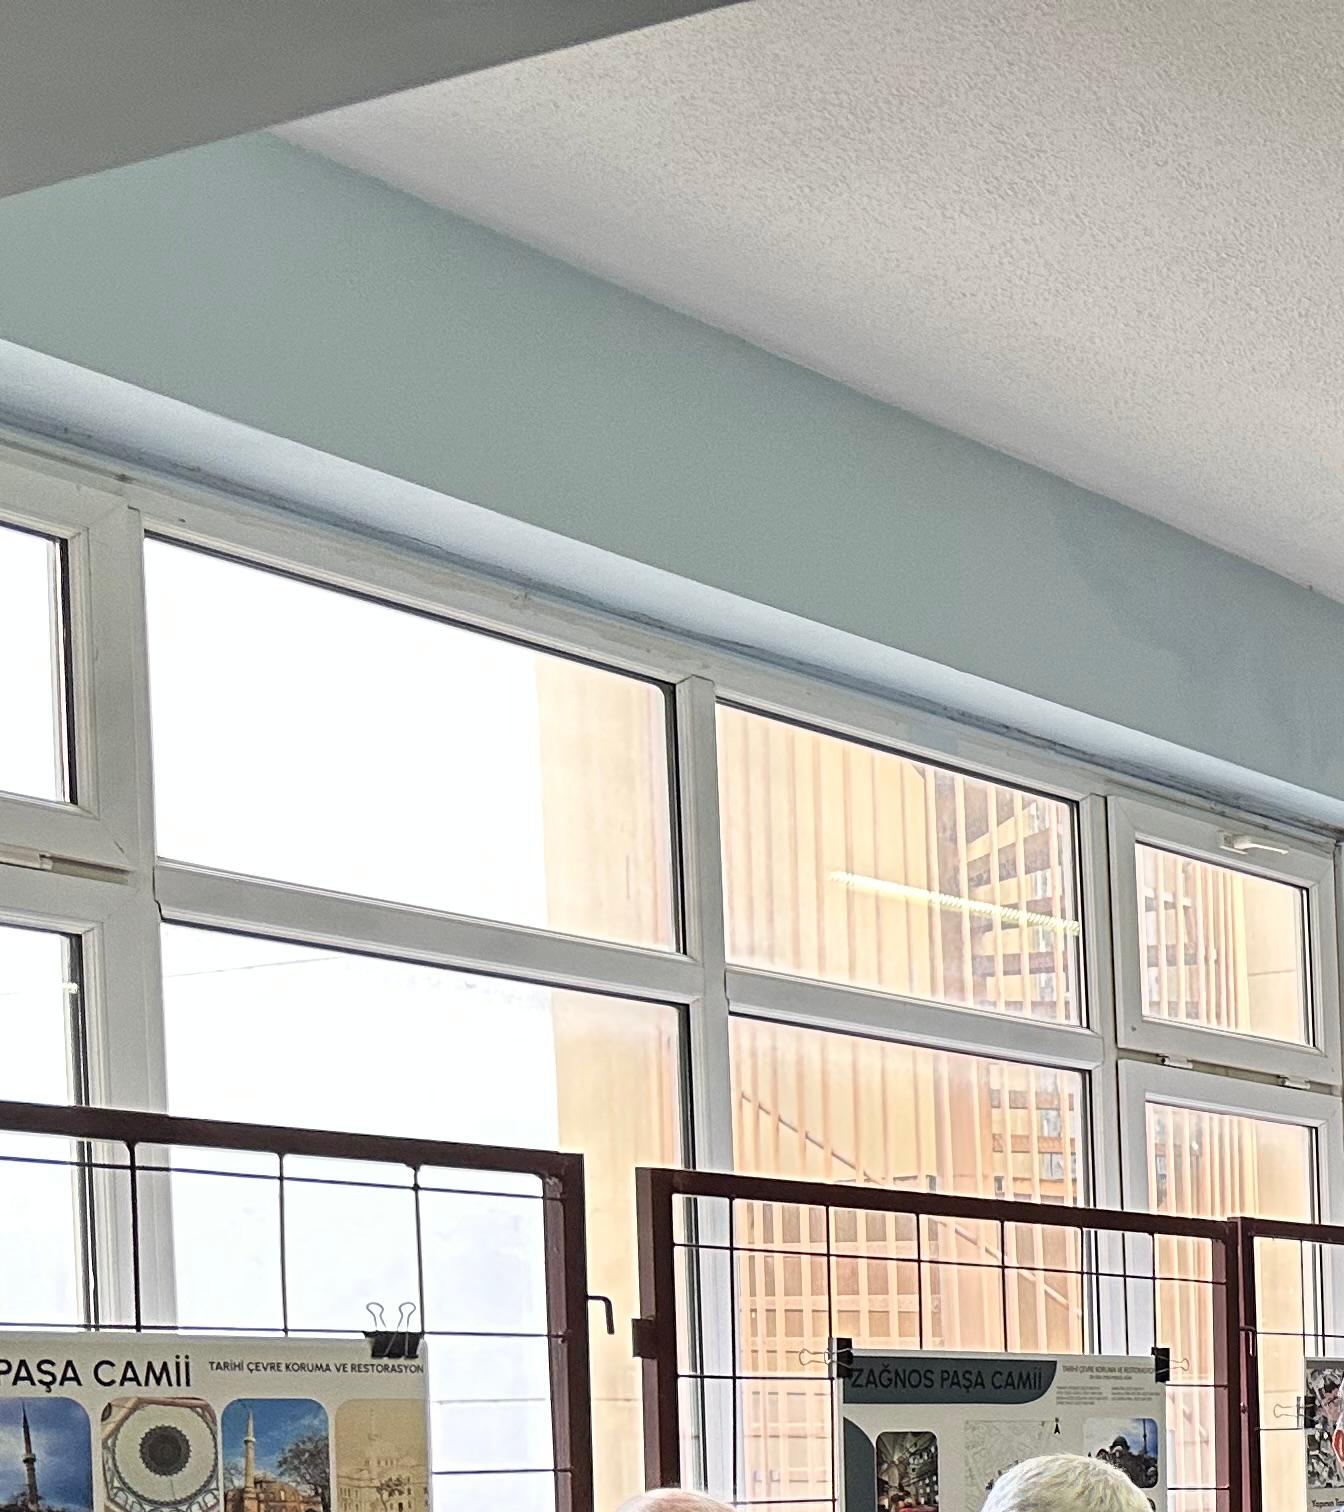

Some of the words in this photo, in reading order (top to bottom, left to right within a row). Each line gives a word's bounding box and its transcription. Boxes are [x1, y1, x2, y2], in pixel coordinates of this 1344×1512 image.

[0, 1359, 83, 1393] PAŞA
[93, 1354, 192, 1387] CAMİİ
[209, 1359, 244, 1371] TARİHİ
[247, 1361, 282, 1374] ÇEVRE
[285, 1361, 331, 1373] KORUMA
[335, 1362, 349, 1373] VE
[351, 1362, 424, 1374] RESTORASYON
[851, 1363, 935, 1389] ZAĞNOS
[941, 1369, 986, 1393] PAŞA
[991, 1366, 1042, 1391] CAMİİ
